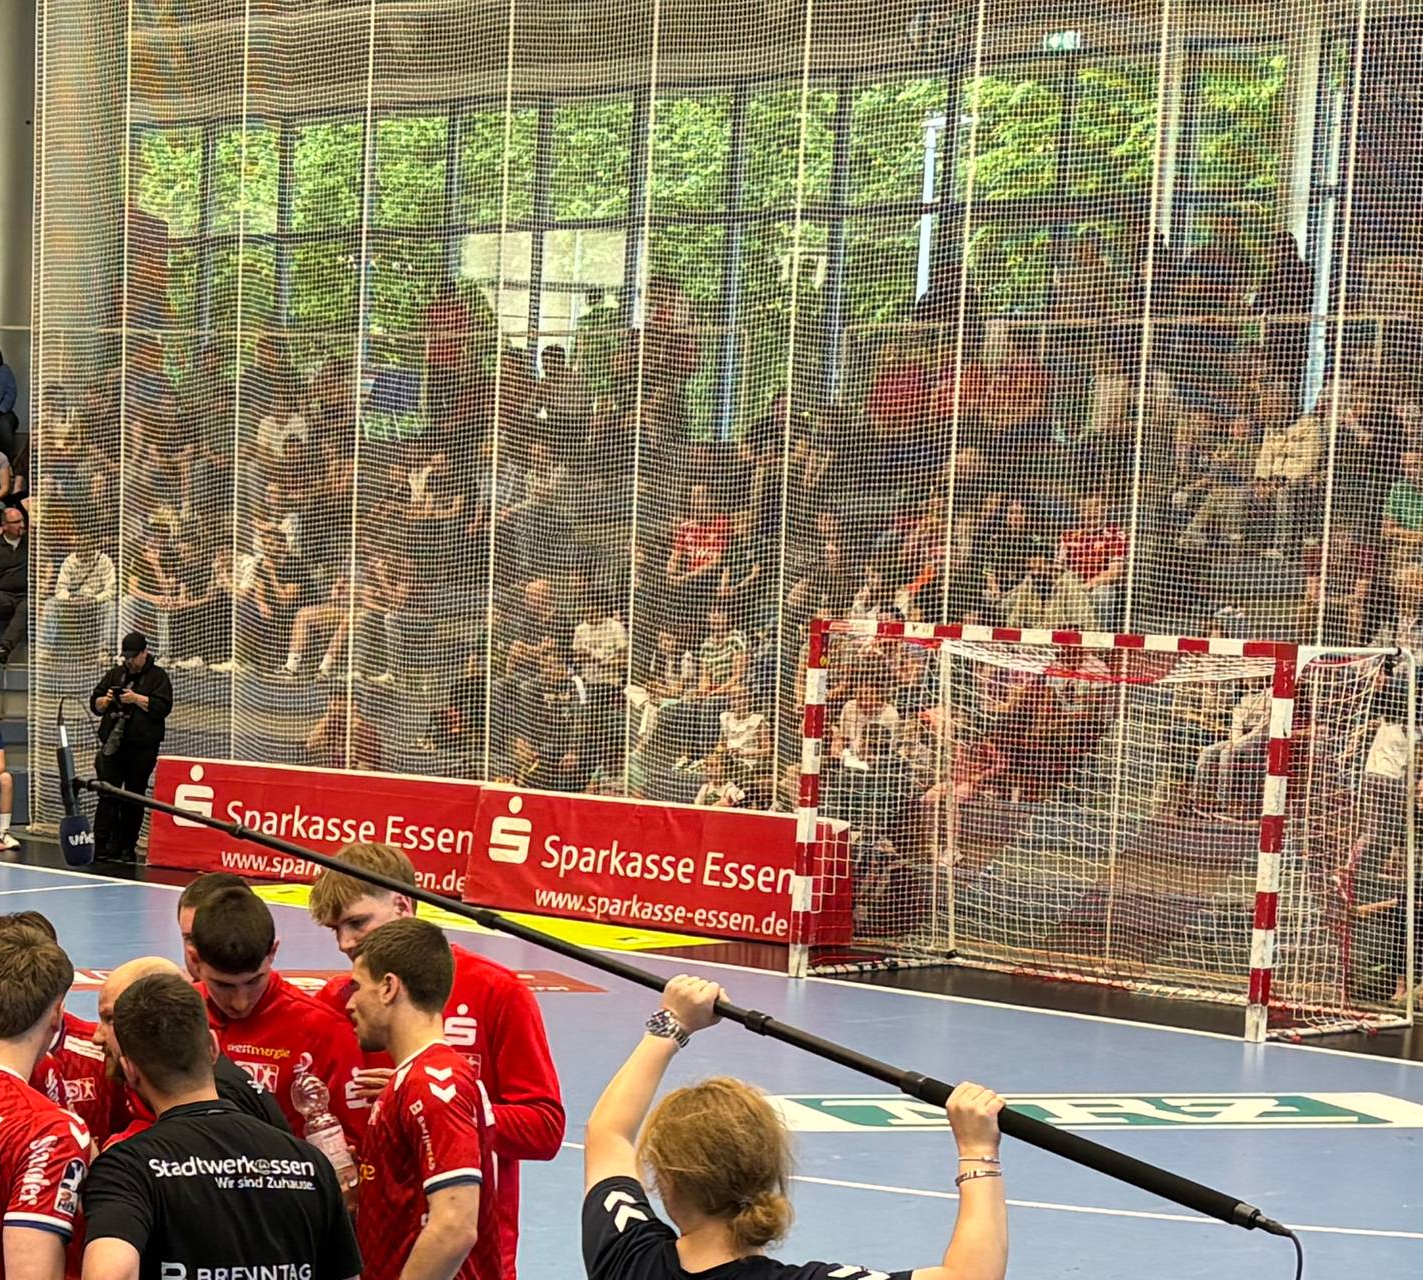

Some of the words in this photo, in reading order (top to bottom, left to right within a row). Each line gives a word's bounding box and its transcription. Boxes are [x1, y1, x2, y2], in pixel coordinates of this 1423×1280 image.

[226, 800, 376, 844] Sparkasse
[385, 815, 474, 855] Essen
[541, 834, 695, 884] Sparkasse
[703, 851, 796, 895] Essen
[535, 888, 789, 936] www.sparkasse-essen.de
[215, 1177, 235, 1188] Wir
[237, 1177, 263, 1188] sind
